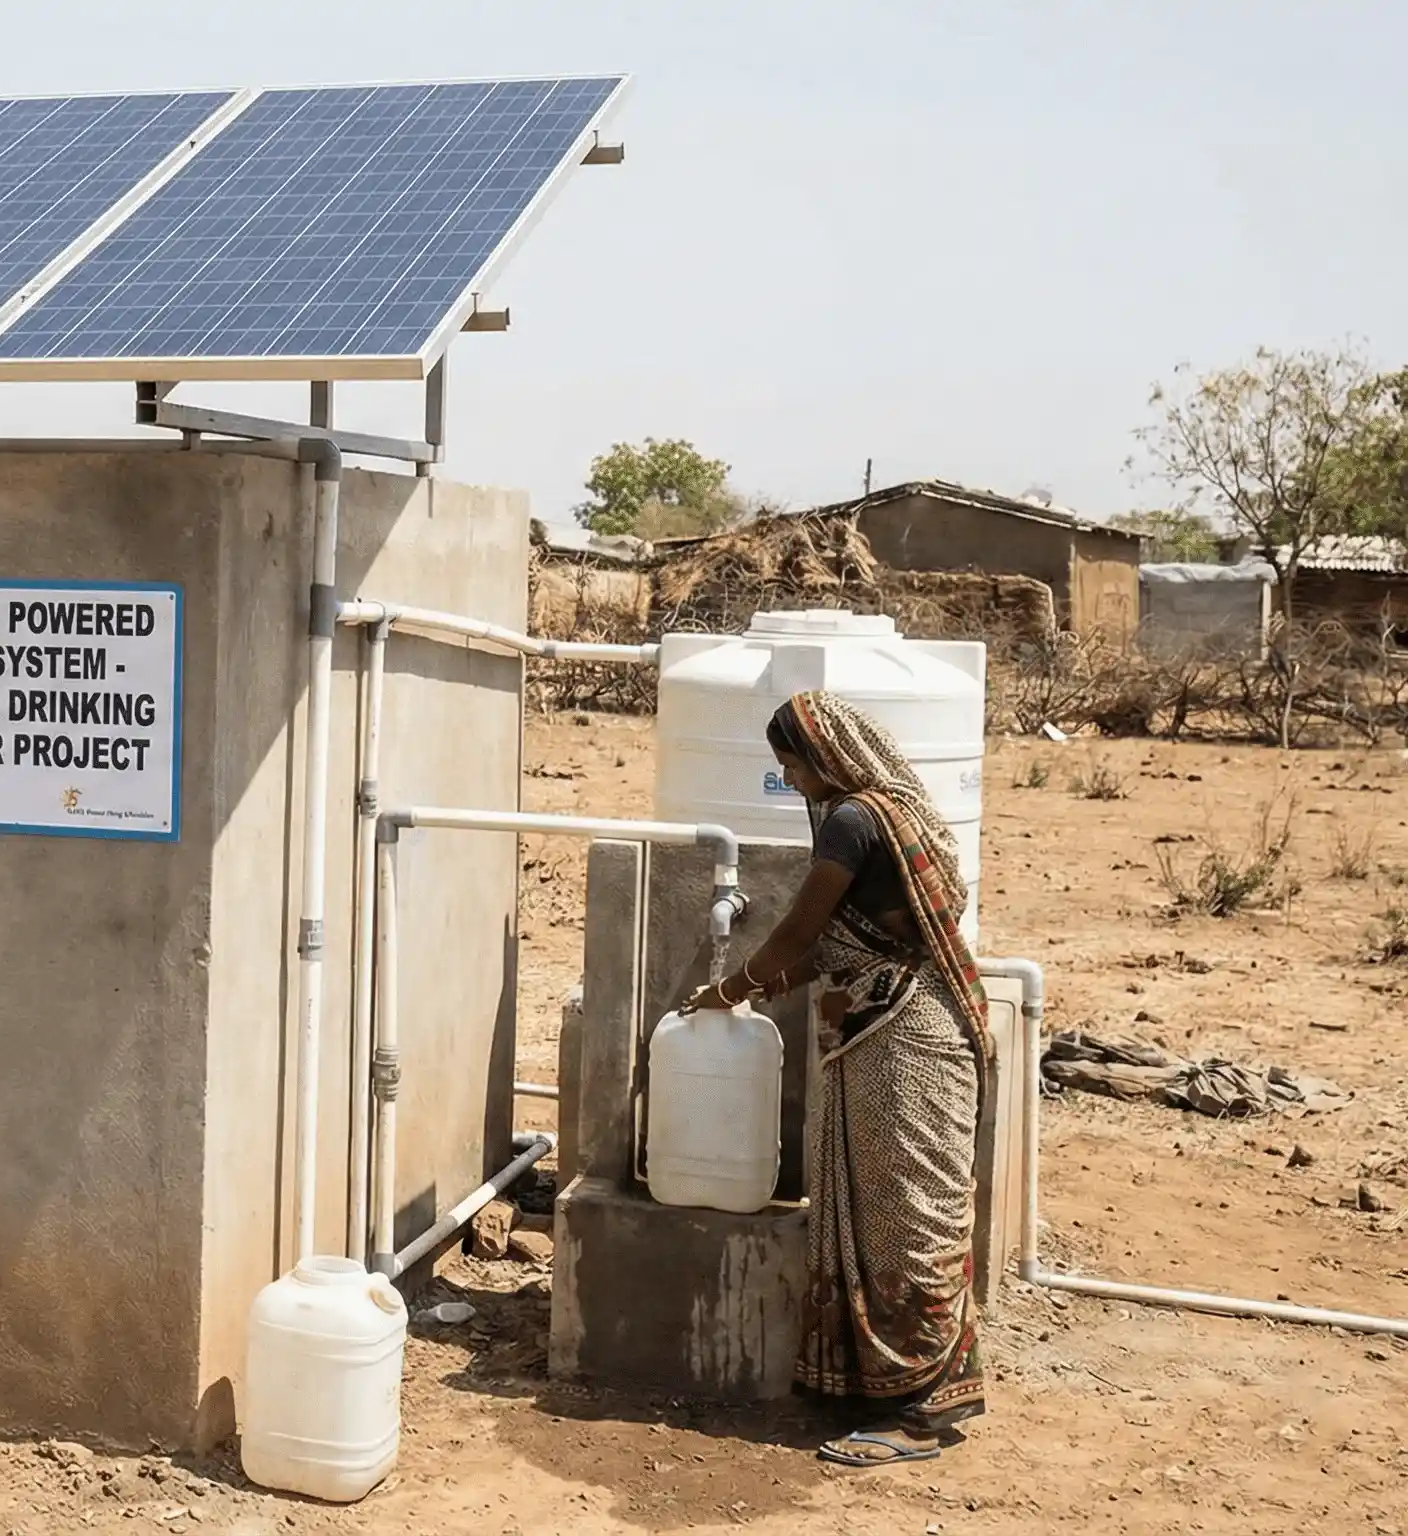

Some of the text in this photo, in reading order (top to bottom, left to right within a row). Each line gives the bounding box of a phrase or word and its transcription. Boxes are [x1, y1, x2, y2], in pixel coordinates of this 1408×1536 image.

[9, 601, 155, 637] POWERED
[115, 664, 126, 673] -
[8, 689, 156, 727] DRINKING
[13, 733, 151, 771] PROJECT
